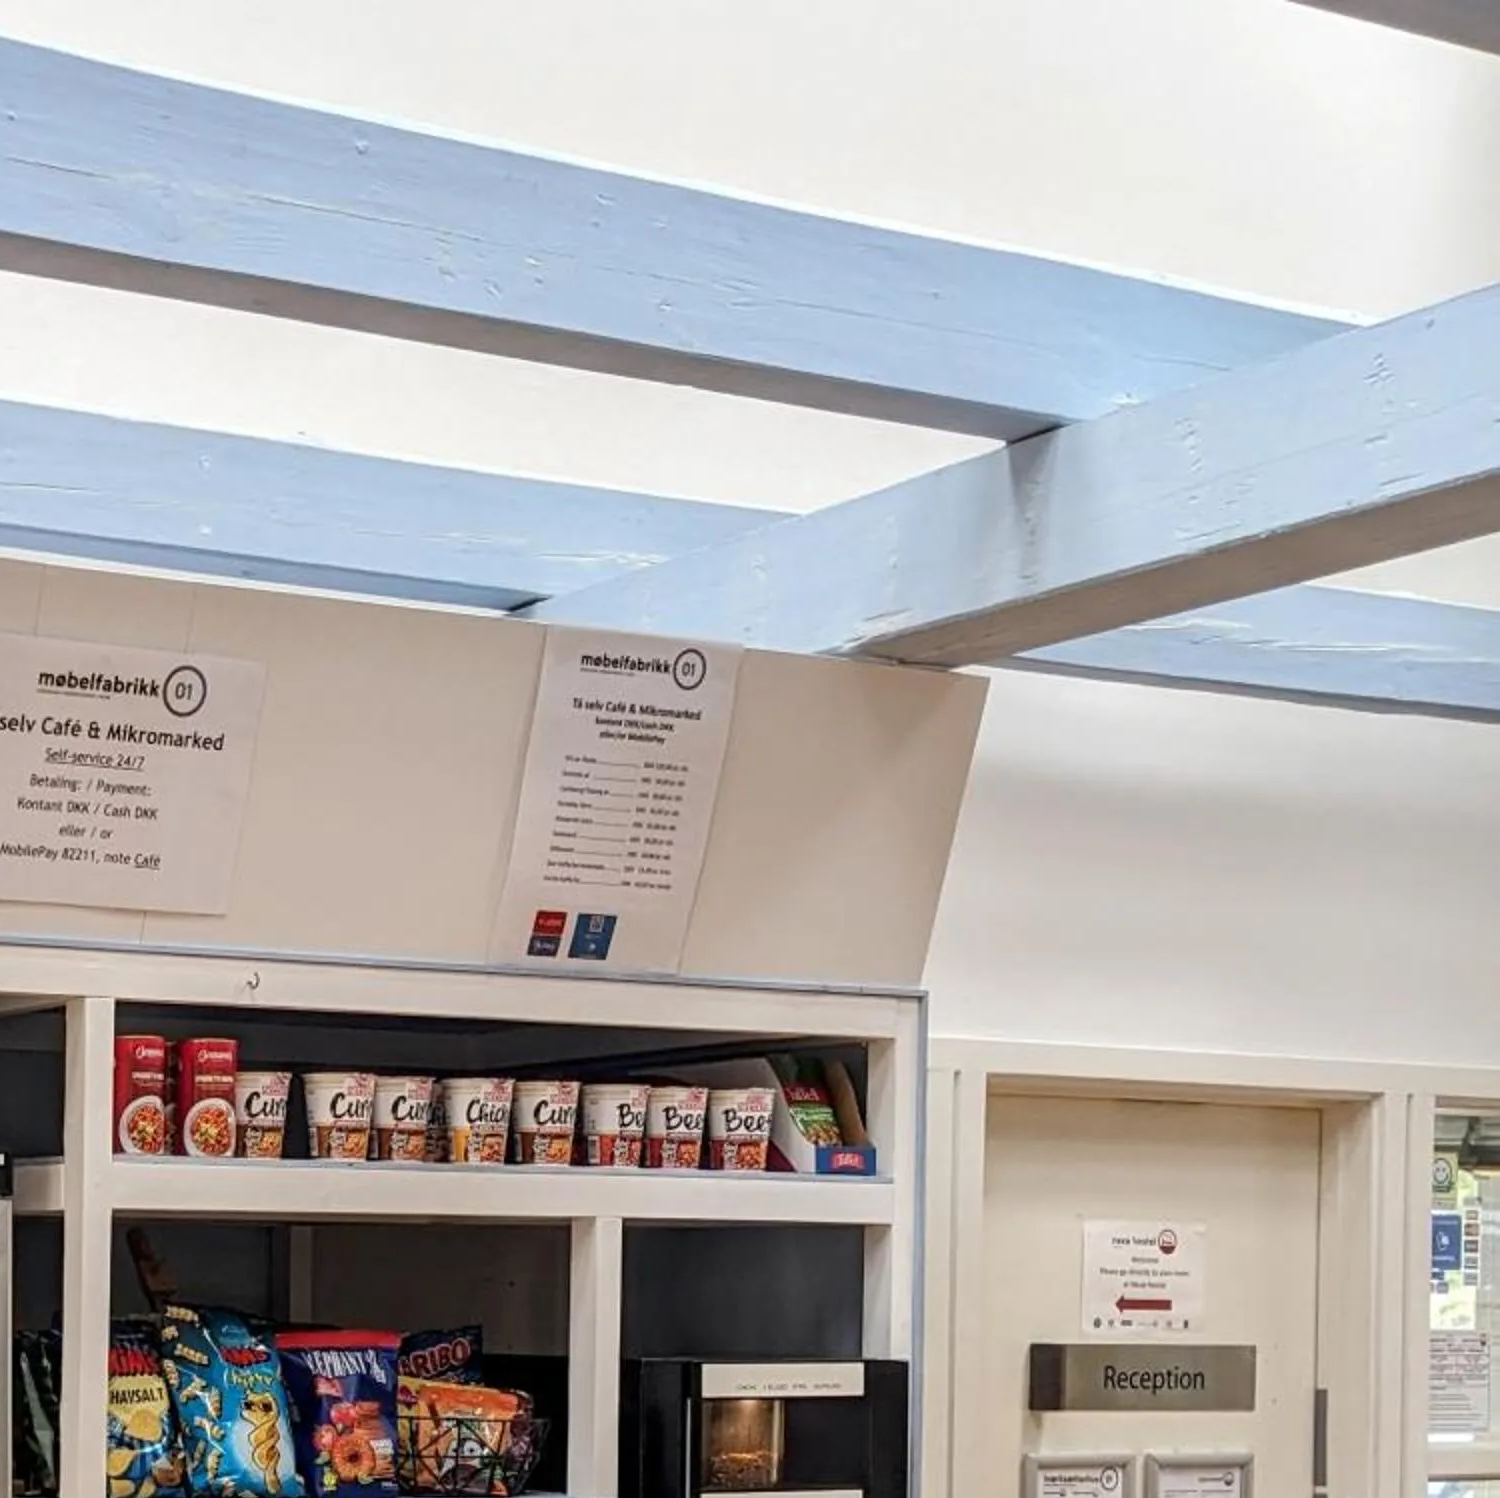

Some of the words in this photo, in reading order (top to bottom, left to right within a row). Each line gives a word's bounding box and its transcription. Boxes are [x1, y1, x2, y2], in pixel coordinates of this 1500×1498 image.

[580, 652, 670, 674] møbelfabrikk
[38, 671, 160, 697] møbelfabrikk
[0, 714, 36, 732] selv
[41, 717, 81, 737] Café
[87, 722, 100, 739] &
[107, 724, 225, 751] Mikromarked
[45, 748, 113, 767] Self-service
[117, 754, 145, 769] 24/7
[96, 779, 151, 796] Payment:
[17, 797, 62, 812] Kontant
[67, 801, 90, 814] DKK
[103, 803, 131, 818] Cash
[135, 806, 158, 819] DKK
[0, 843, 58, 861] MobilePay
[104, 852, 131, 865] note
[1103, 1364, 1205, 1395] Reception
